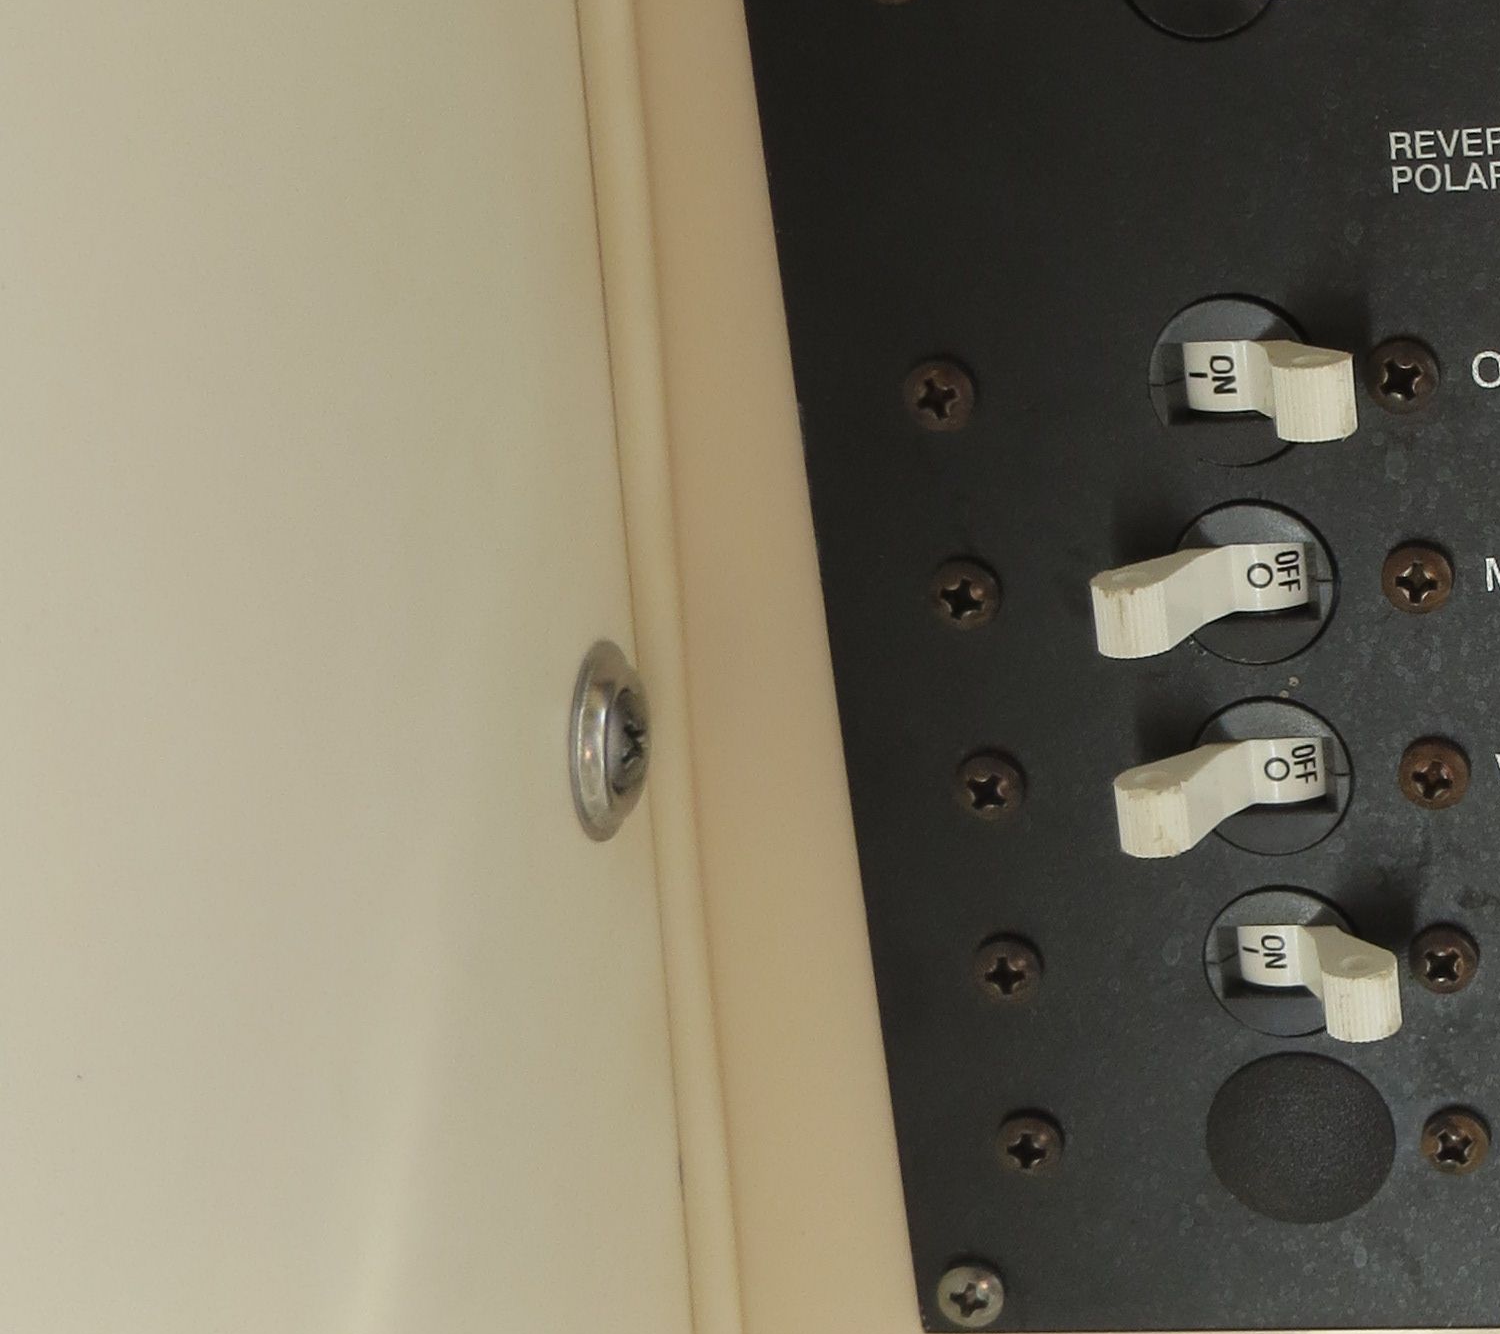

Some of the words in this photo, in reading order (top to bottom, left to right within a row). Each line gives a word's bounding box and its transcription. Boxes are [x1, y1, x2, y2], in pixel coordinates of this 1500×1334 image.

[1210, 355, 1237, 394] ON
[1275, 550, 1301, 592] OFF
[1291, 744, 1318, 784] OFF
[1261, 934, 1288, 969] ON
